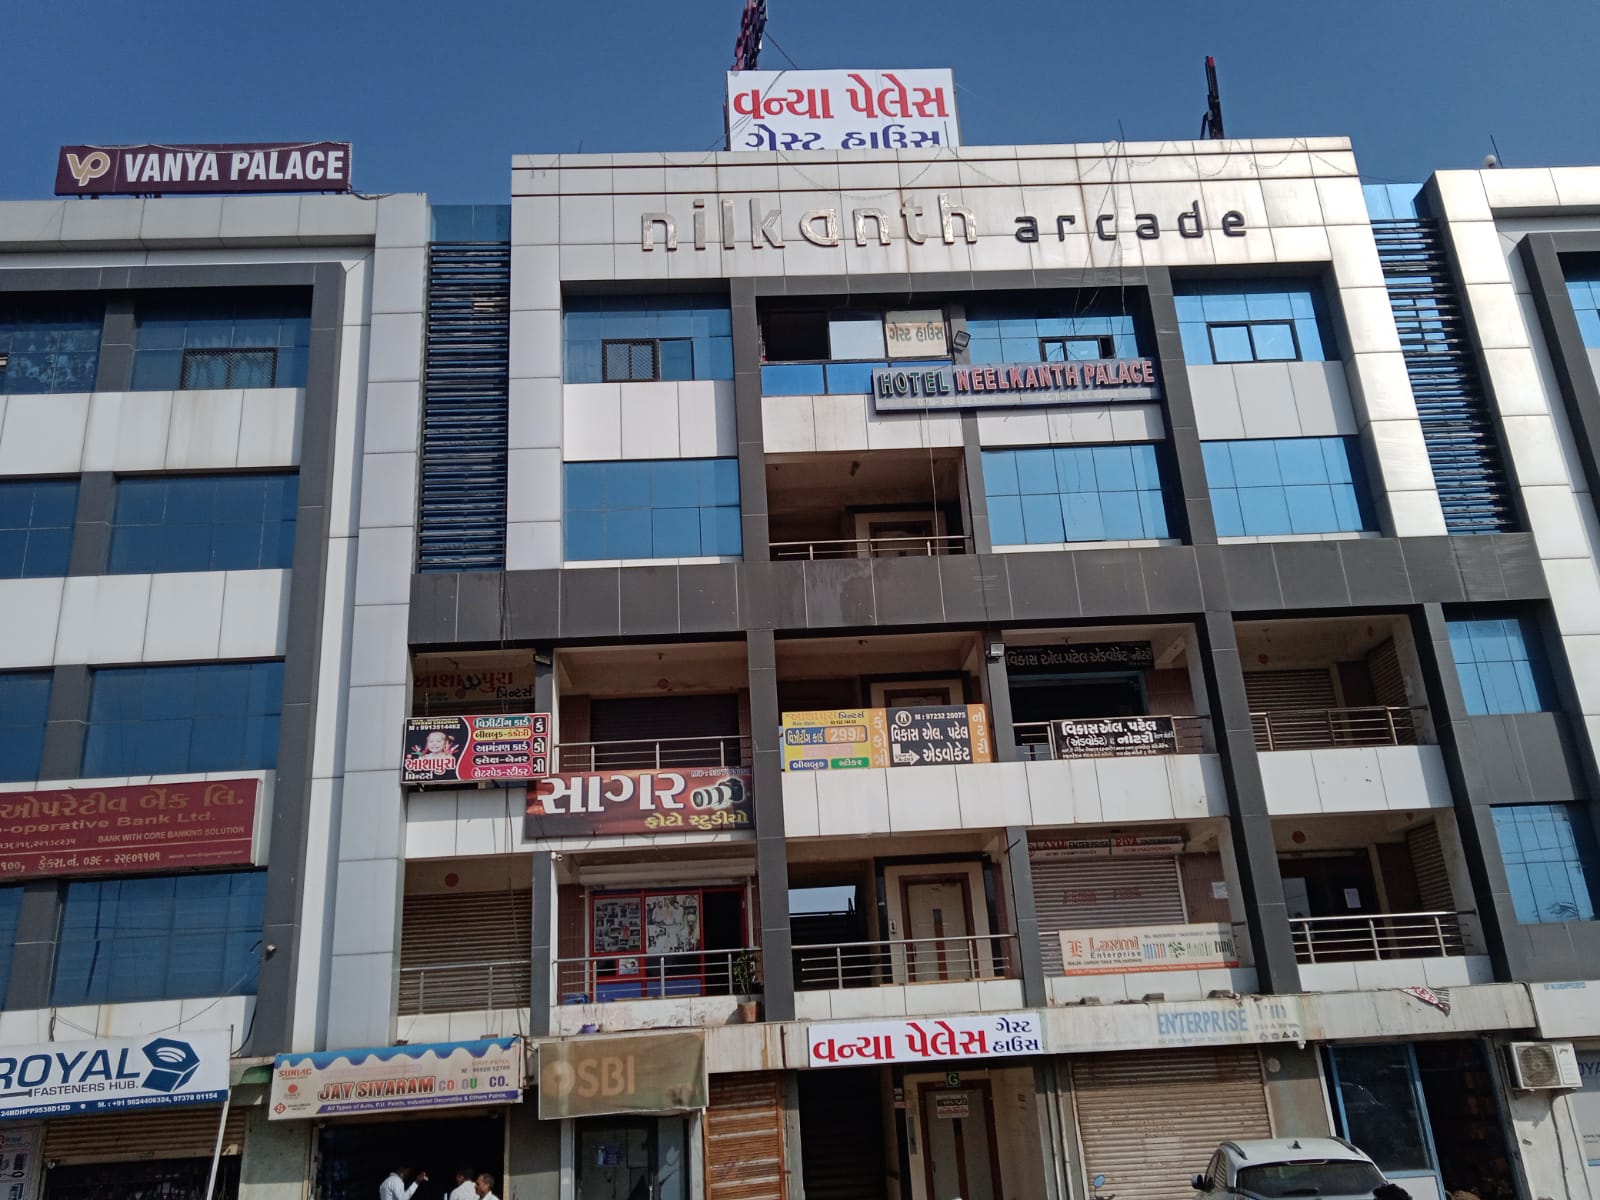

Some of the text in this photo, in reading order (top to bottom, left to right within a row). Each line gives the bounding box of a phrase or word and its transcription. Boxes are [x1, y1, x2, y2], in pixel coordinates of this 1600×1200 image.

[734, 73, 950, 120] વન્યા પેલેસ
[125, 151, 344, 182] VANYA PALACE
[641, 193, 1247, 251] nilkanth arcade
[880, 359, 1156, 395] HOTEL NEELKANTH PALACE
[891, 724, 919, 742] વિકાસ
[947, 721, 969, 739] પટેલ
[538, 773, 687, 814] સાગર
[117, 814, 169, 827] Bank
[177, 811, 216, 823] Ltd.
[98, 834, 120, 844] BANK
[122, 833, 142, 842] WITH
[144, 831, 165, 841] CORE
[205, 826, 244, 836] SOLUTION
[1090, 951, 1142, 959] Enterprise
[996, 1018, 1032, 1033] ગેસ્ટ
[1157, 1009, 1249, 1035] ENTERPRISE
[813, 1021, 990, 1062] વન્યા પેલેસ
[993, 1036, 1040, 1053] હાઉસ
[34, 1081, 138, 1096] FASTENERS HUB.
[319, 1083, 354, 1100] JAY
[357, 1076, 436, 1098] SIYARAM
[489, 1075, 509, 1088] CO.
[577, 1056, 636, 1097] SBI
[948, 1073, 959, 1086] G
